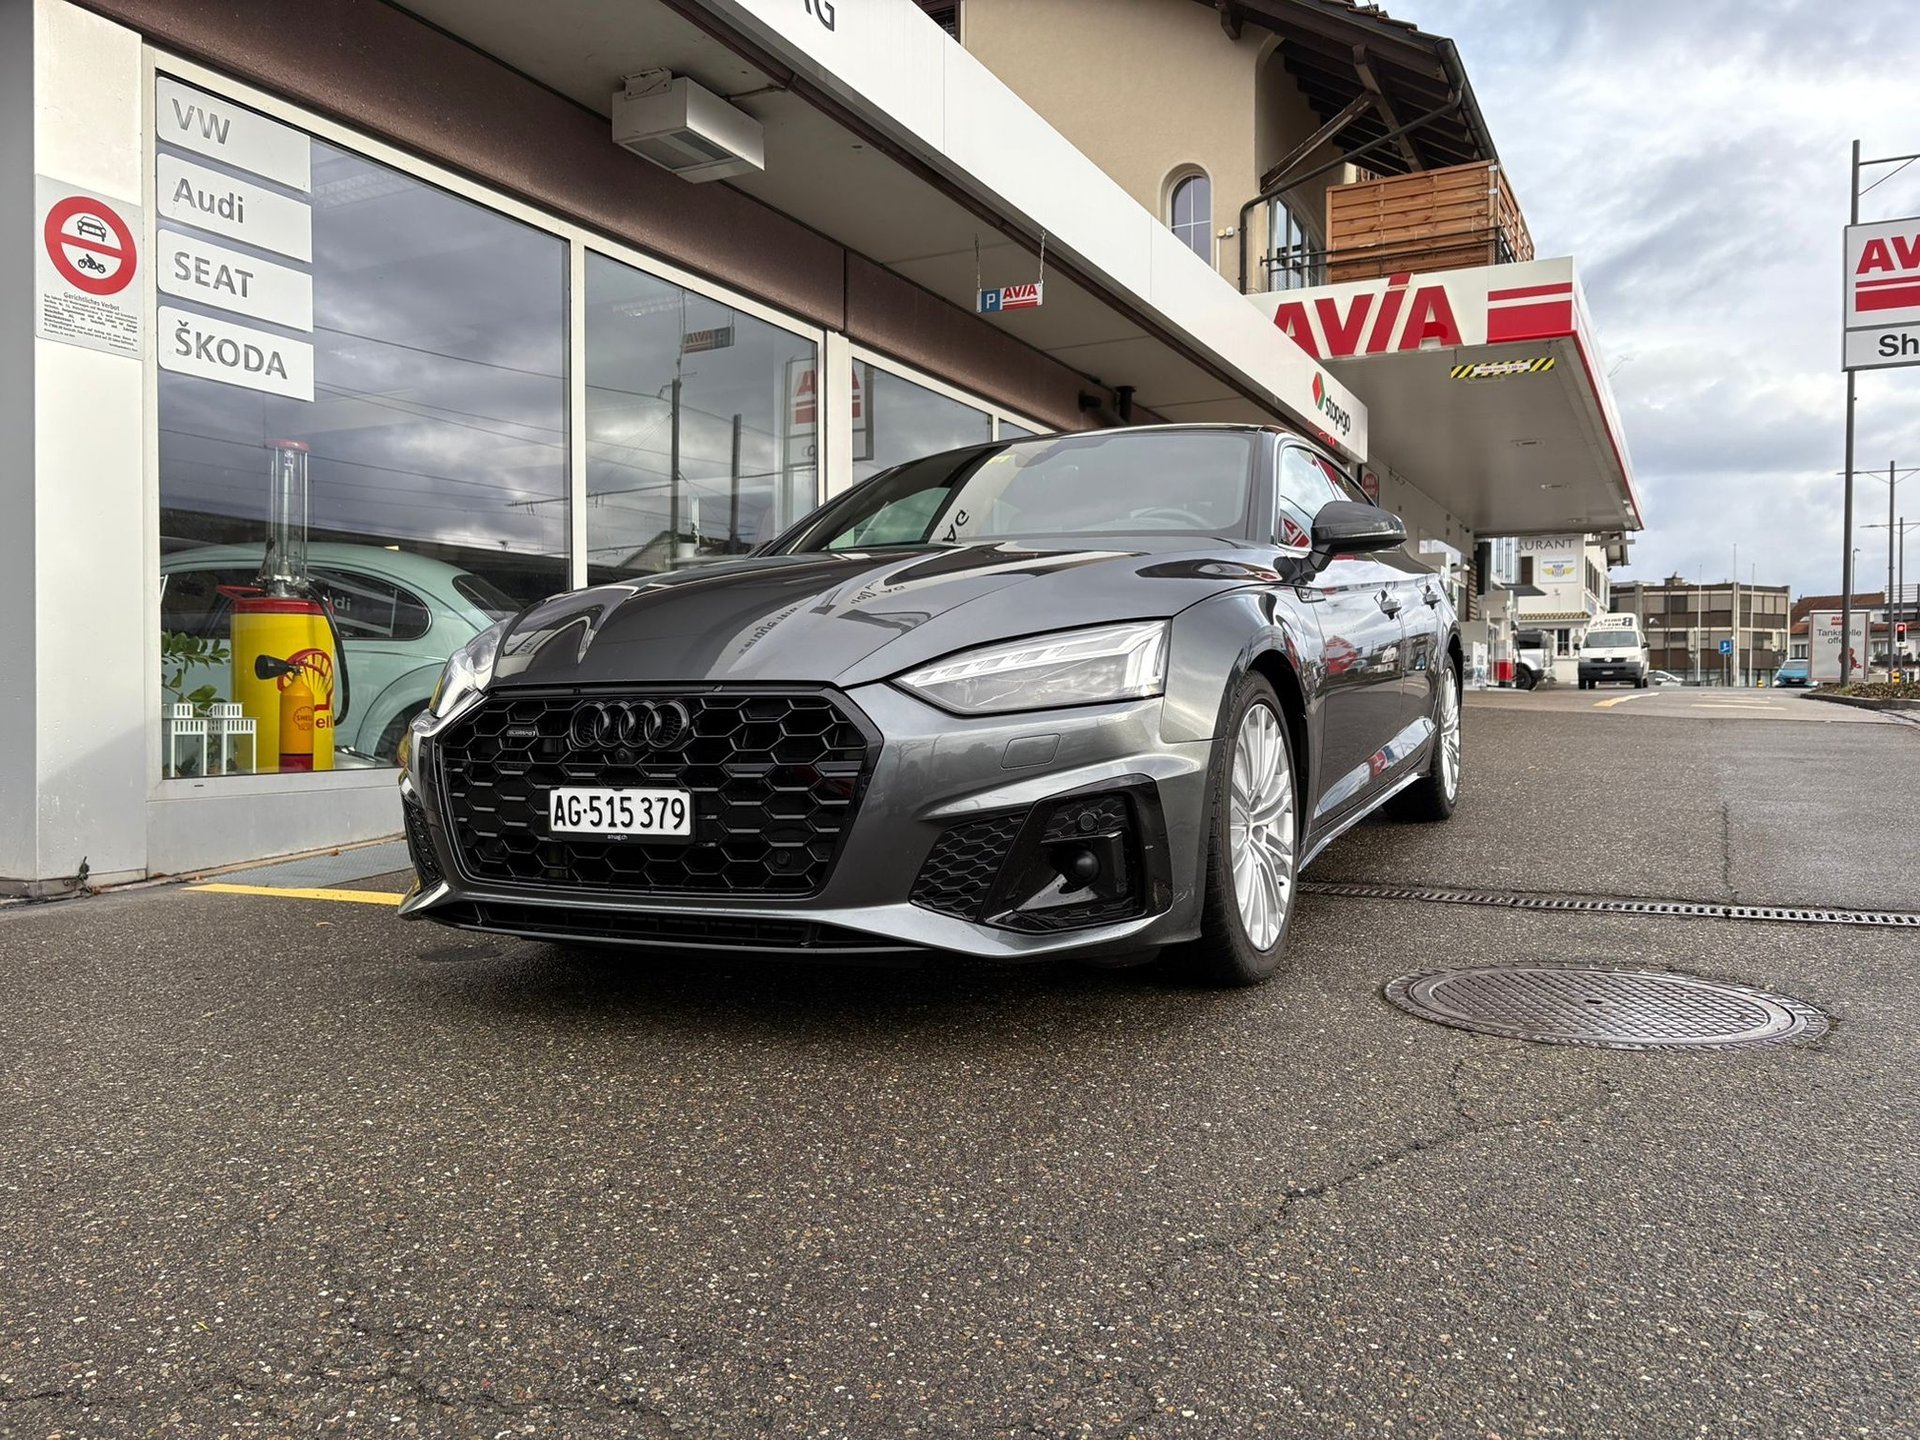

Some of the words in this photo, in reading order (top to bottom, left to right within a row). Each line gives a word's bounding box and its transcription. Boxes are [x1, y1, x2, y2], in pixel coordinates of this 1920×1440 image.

[172, 98, 231, 145] VW
[172, 177, 244, 224] Audi
[174, 251, 254, 298] SEAT
[986, 293, 996, 309] P
[1003, 284, 1038, 300] AVIA
[63, 292, 101, 307] Gerichtliches
[100, 301, 120, 312] Verbot
[1273, 272, 1463, 359] AVIA
[175, 319, 288, 380] ŠKODA
[1817, 629, 1862, 637] Tankslle
